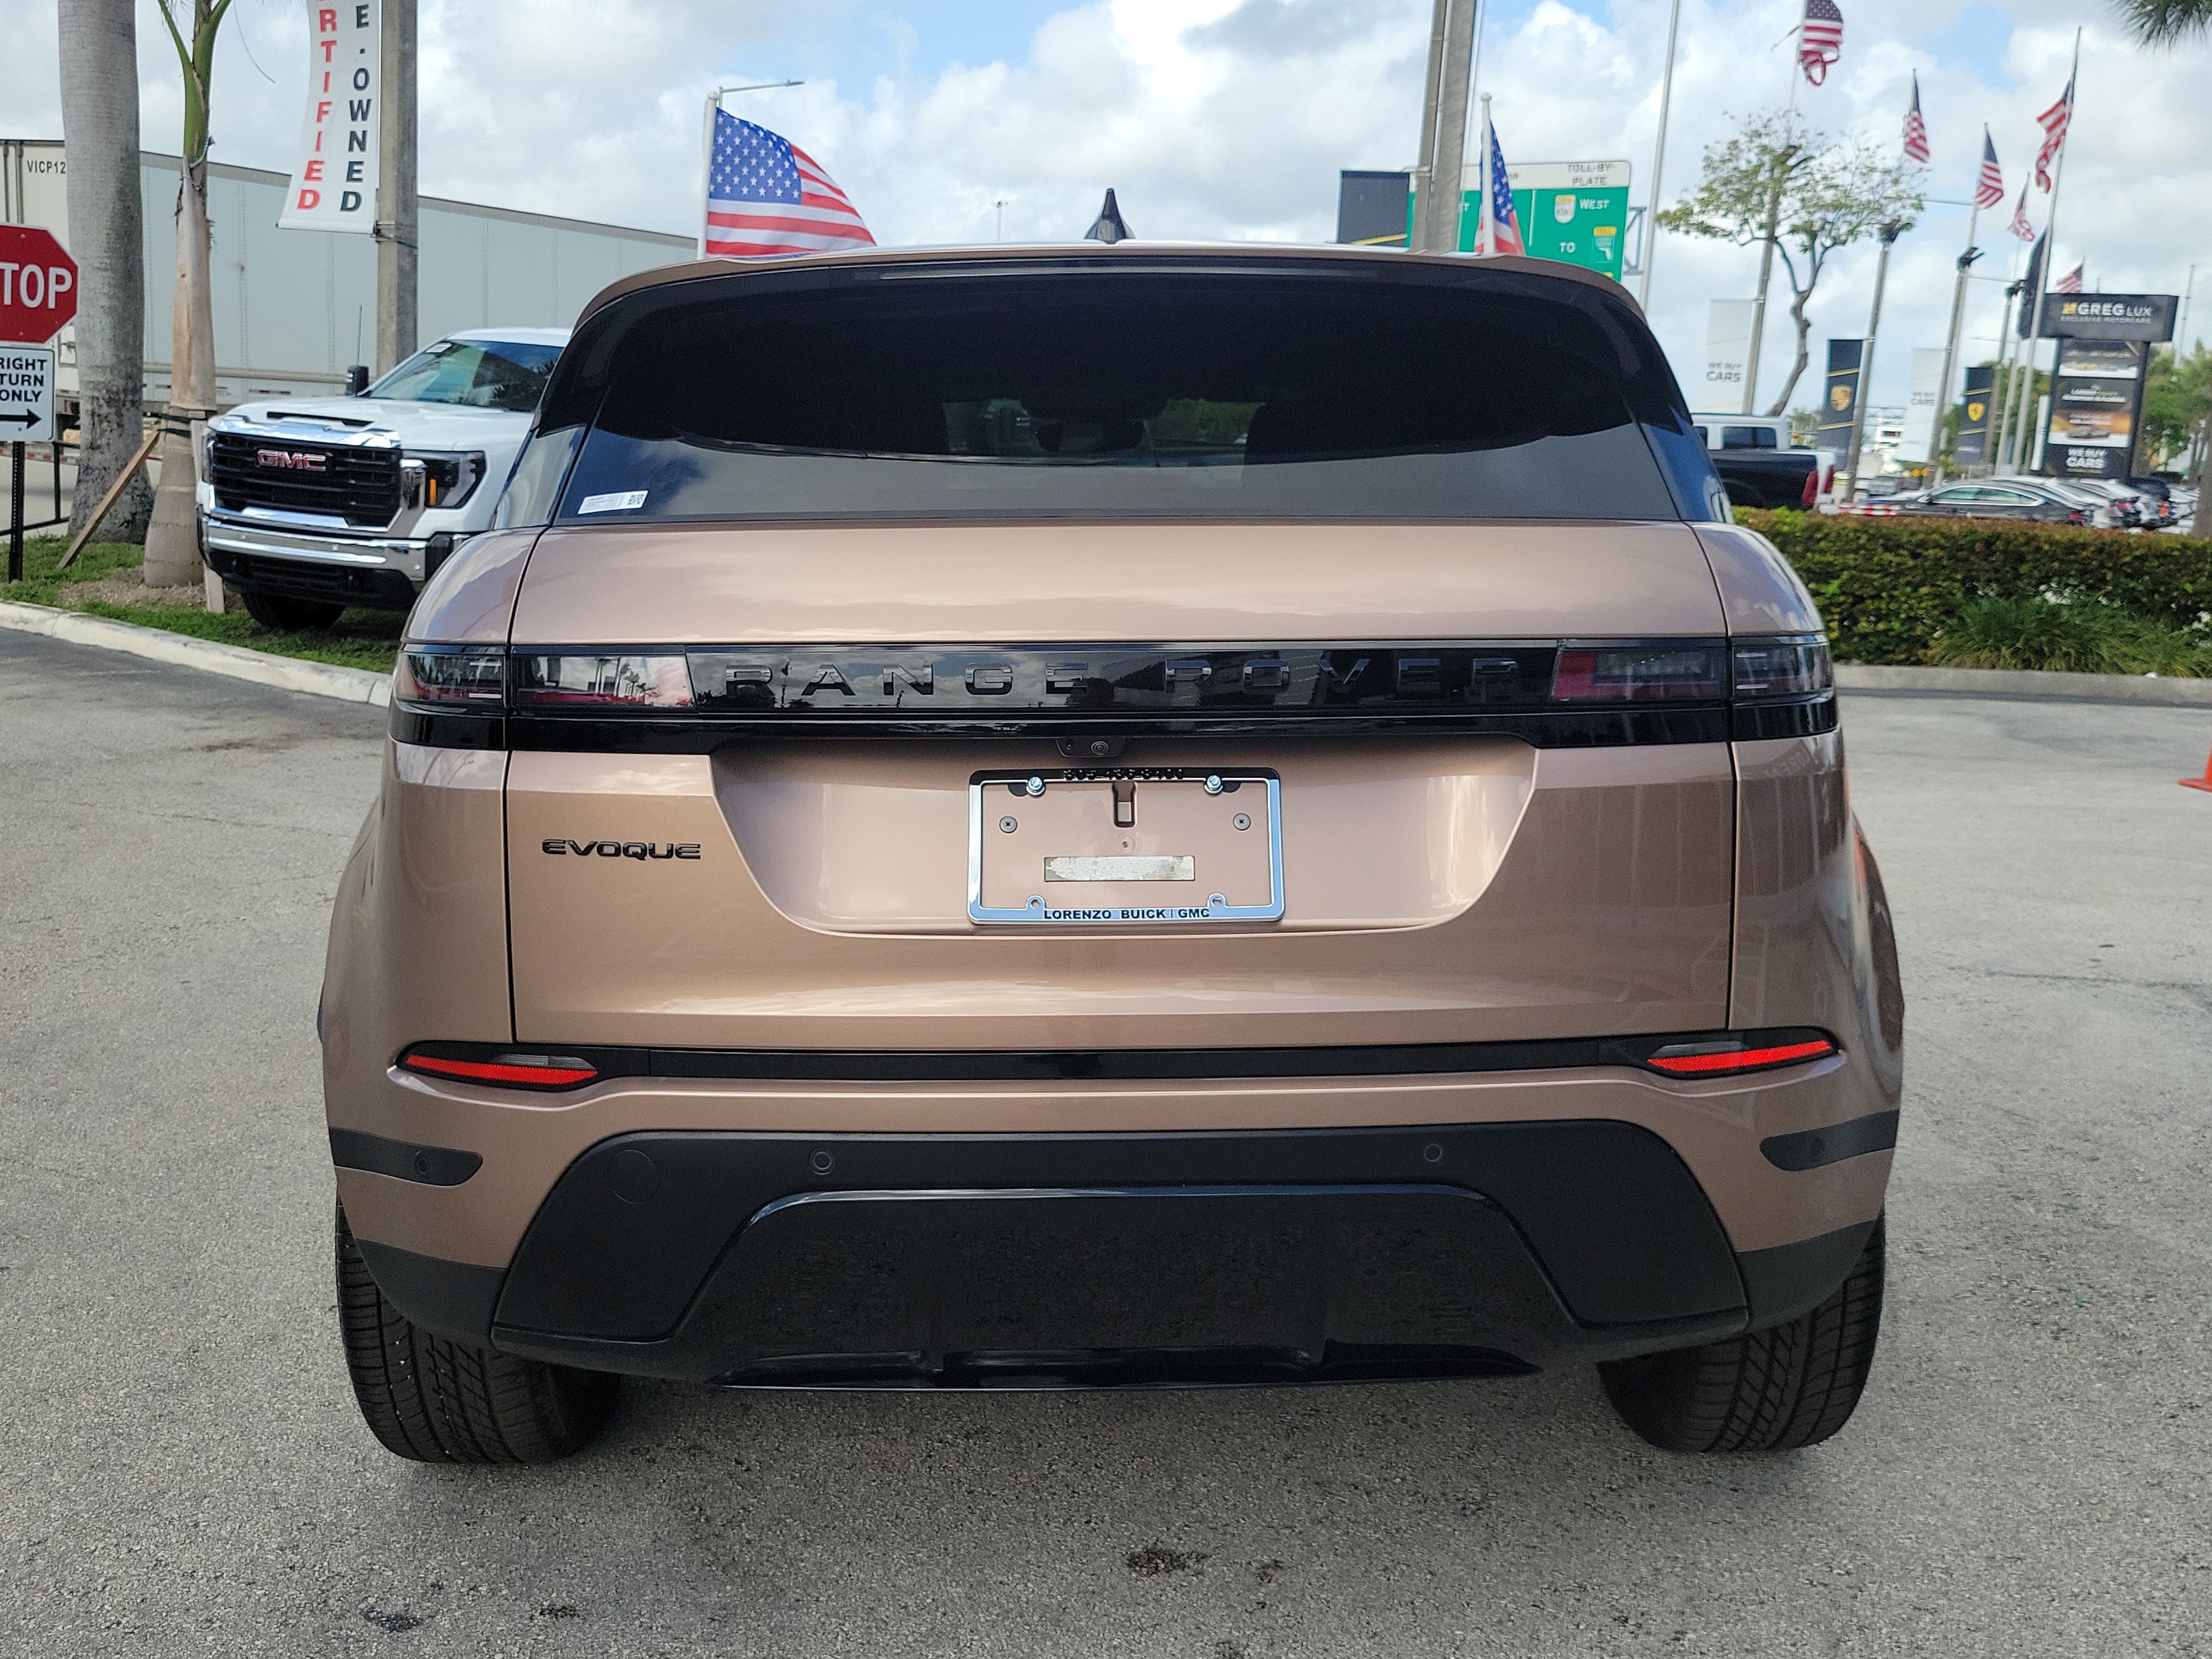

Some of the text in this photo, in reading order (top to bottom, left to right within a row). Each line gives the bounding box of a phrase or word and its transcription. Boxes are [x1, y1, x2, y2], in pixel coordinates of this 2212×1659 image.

[297, 0, 337, 211] RTIFIED
[27, 160, 66, 174] VICP12
[1571, 176, 1607, 187] PLATE
[1579, 198, 1610, 210] WEST
[1560, 241, 1576, 253] TO
[0, 373, 45, 387] TURN
[1706, 370, 1741, 383] CARS
[0, 388, 43, 402] ONLY
[257, 449, 326, 472] GMC
[2066, 456, 2106, 469] CARS
[726, 662, 1088, 696] RANGE
[542, 838, 701, 861] EVOQUE
[1043, 908, 1210, 919] LORENZO BUICK GMC
